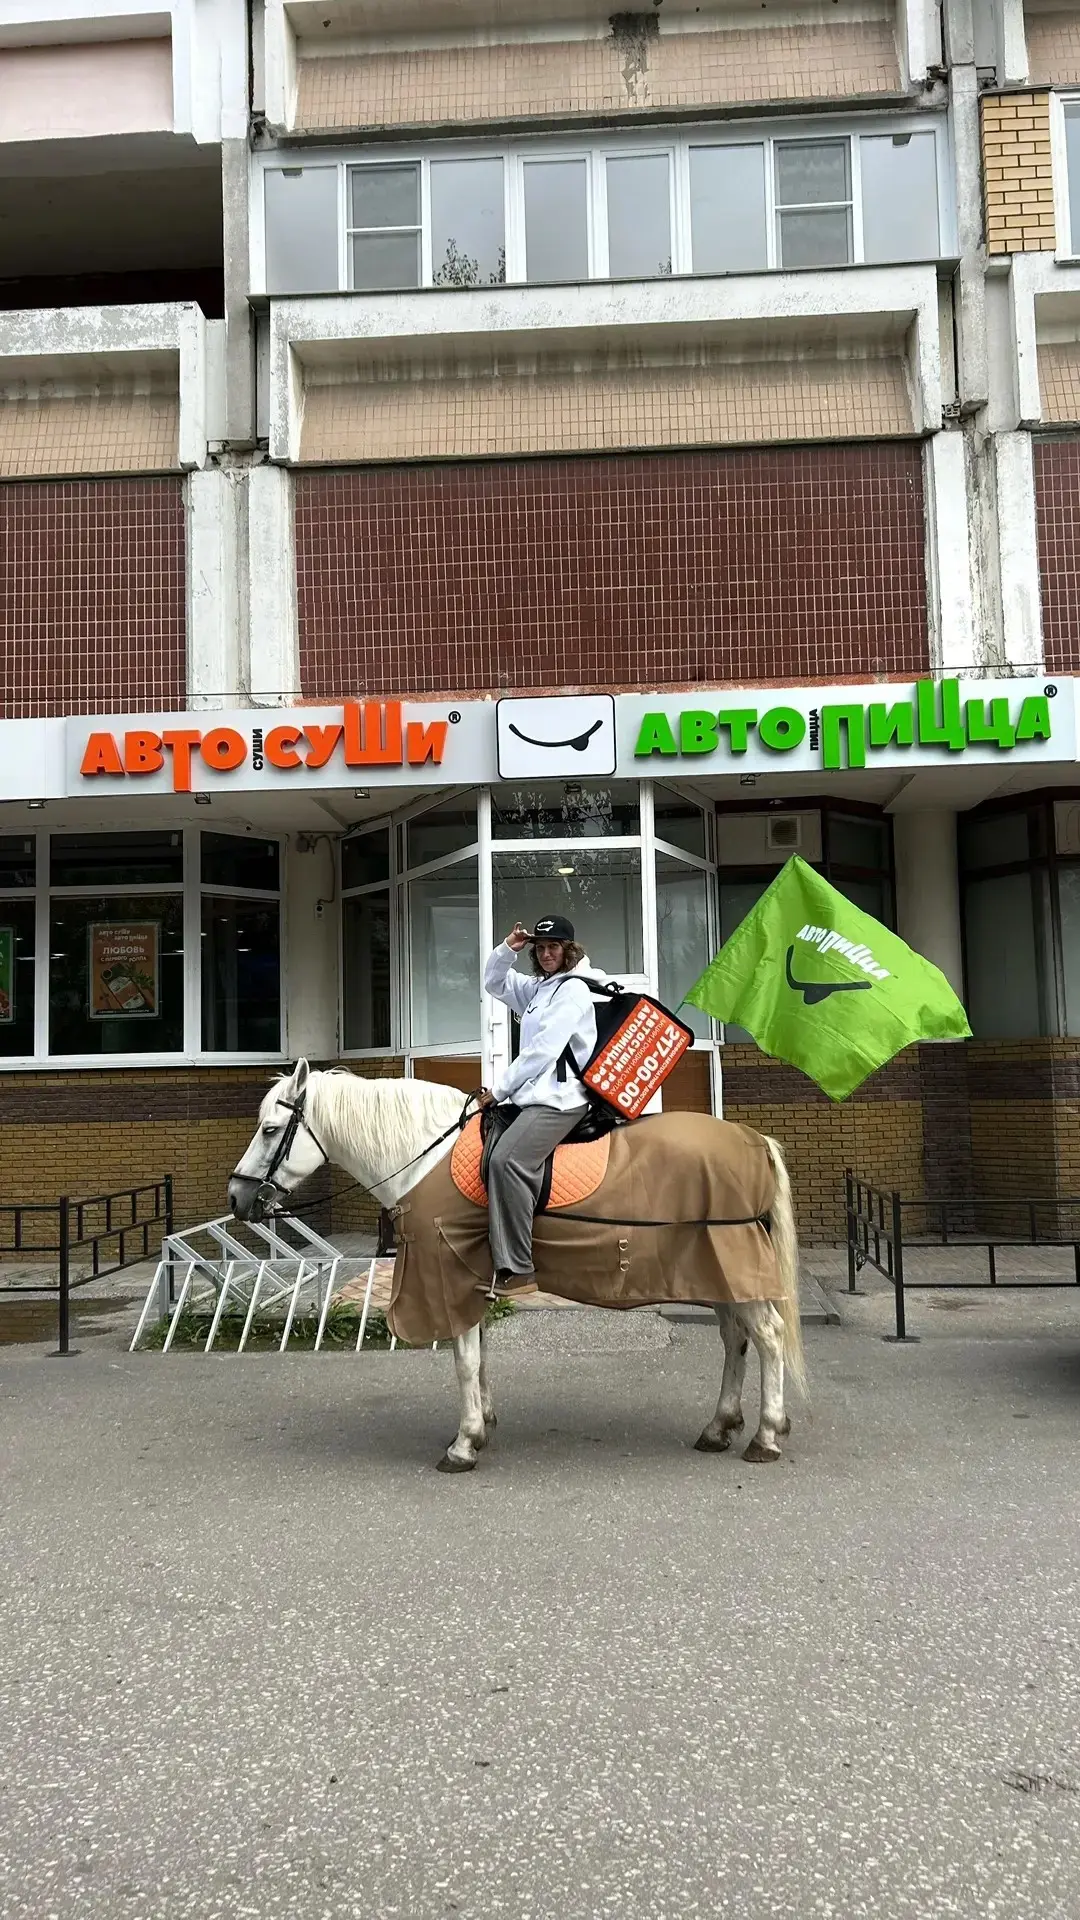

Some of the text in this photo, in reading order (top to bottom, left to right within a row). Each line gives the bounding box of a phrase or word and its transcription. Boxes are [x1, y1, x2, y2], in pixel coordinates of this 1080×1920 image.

[252, 728, 264, 771] СУШИ
[634, 706, 806, 758] АВТО
[808, 708, 820, 751] ПИЦЦА
[80, 727, 248, 793] АВТО
[102, 945, 145, 955] ЛЮБОВЬ
[592, 1003, 651, 1083] АВТОПИЦЦА.РФ
[601, 1010, 659, 1091] АВТОСУШИ.РФ
[650, 1016, 666, 1038] АКЦИИ
[618, 1023, 681, 1109] 217-00-00
[629, 1035, 687, 1114] ТЕЛЕФОН БЕСПЛАТНОЙ ДОСТАВКИ
[630, 1042, 650, 1067] СКИДКИ
[608, 1073, 627, 1097] САЙТАХ
